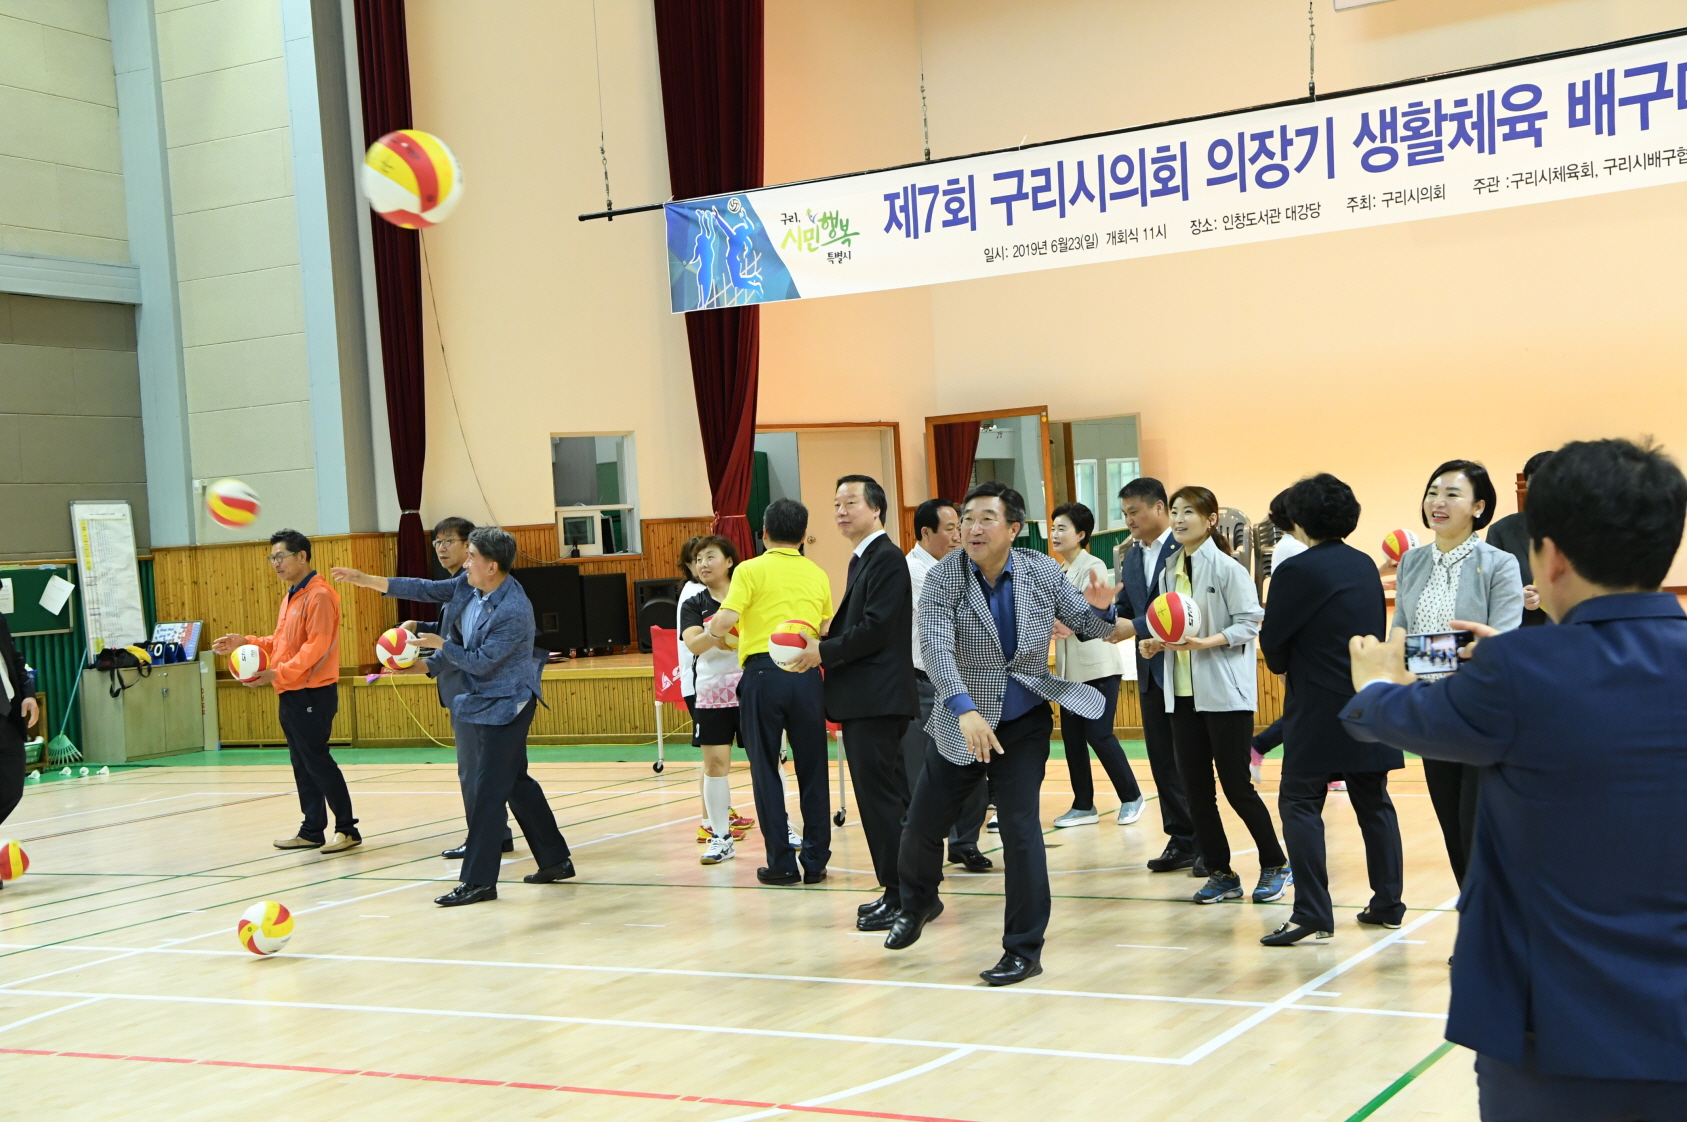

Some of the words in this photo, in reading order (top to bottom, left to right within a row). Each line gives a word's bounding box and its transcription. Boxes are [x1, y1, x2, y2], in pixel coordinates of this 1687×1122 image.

[884, 174, 977, 240] 제7회
[990, 141, 1189, 226] 구리시의회
[1206, 116, 1335, 193] 의장기
[1352, 83, 1548, 174] 생활체육
[1568, 61, 1687, 137] 배구
[826, 251, 851, 265] 특별시
[983, 245, 1009, 263] 일시:
[1012, 239, 1048, 258] 2019년
[1051, 232, 1099, 253] 6월23(일)
[1106, 227, 1139, 246] 개회식
[1143, 223, 1167, 240] 11시
[1190, 217, 1217, 235] 장소:
[1222, 207, 1281, 231] 인창도서관
[1285, 201, 1321, 221] 대강당
[1346, 194, 1376, 213] 주최:
[1381, 183, 1446, 208] 구리시의회
